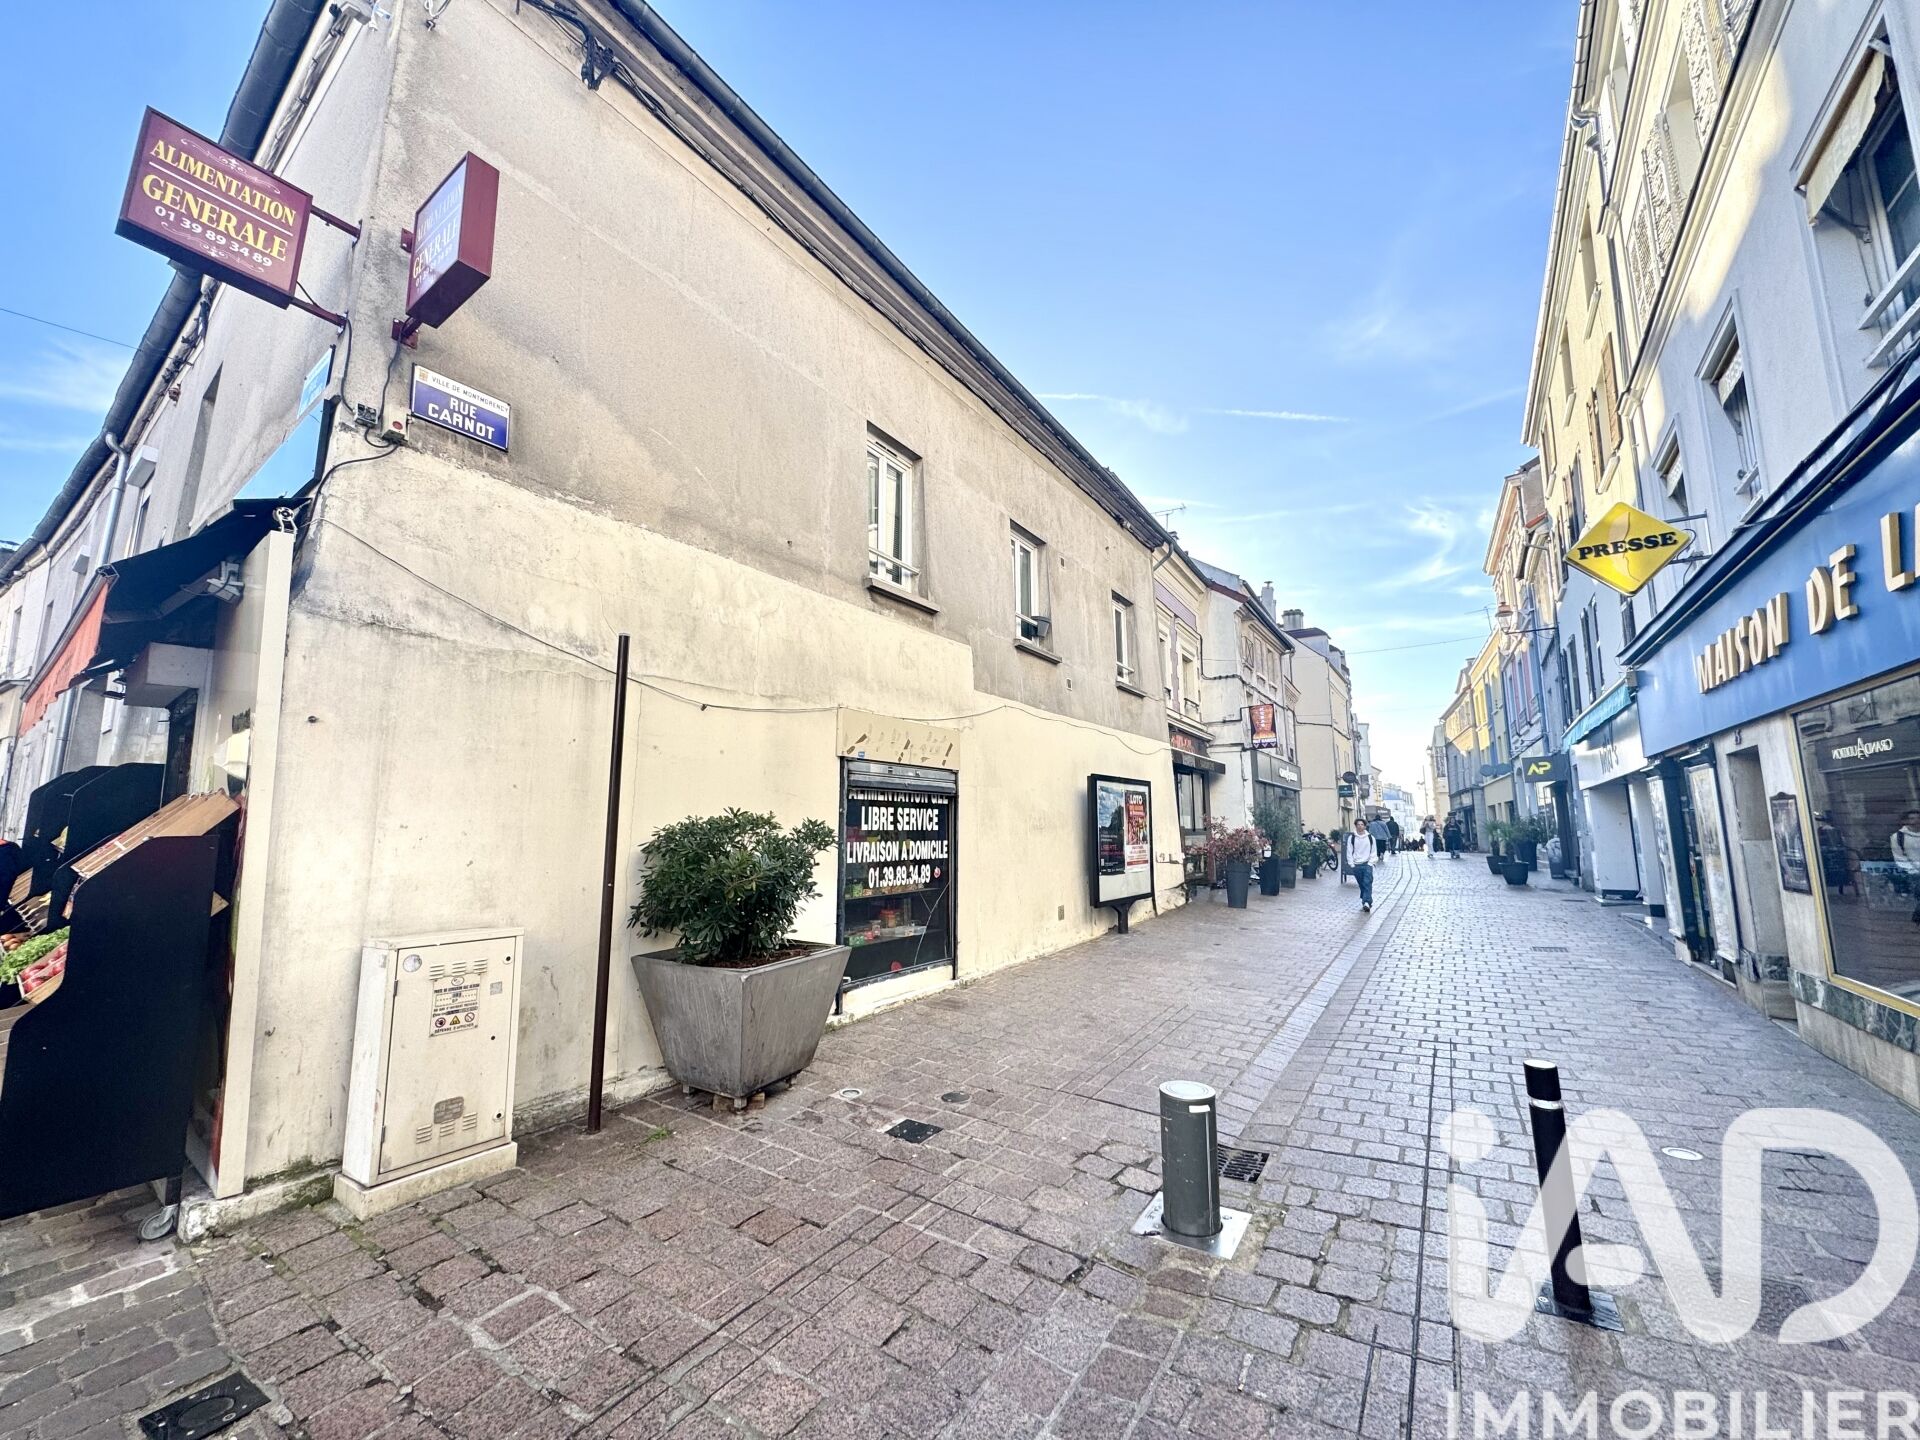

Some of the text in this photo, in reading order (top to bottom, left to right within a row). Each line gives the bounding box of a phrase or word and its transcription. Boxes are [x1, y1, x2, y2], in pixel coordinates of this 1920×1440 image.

[151, 140, 296, 227] ALIMENTATION
[142, 174, 288, 262] GENERALE
[155, 205, 273, 267] 01 39 89 34 89
[413, 216, 458, 279] GENERALE
[432, 376, 509, 413] VILLE DE MONTMORENCY
[450, 397, 478, 419] RUE
[428, 403, 495, 440] CARNOT
[1578, 531, 1678, 560] PRESSE
[1697, 502, 1920, 695] MAISON DE L
[1527, 761, 1552, 776] AP
[861, 806, 939, 831] LIBRE SERVICE
[847, 841, 899, 864] LIVRAISON
[909, 840, 948, 861] DOMICILE
[868, 864, 931, 888] 01.39.89.34.89
